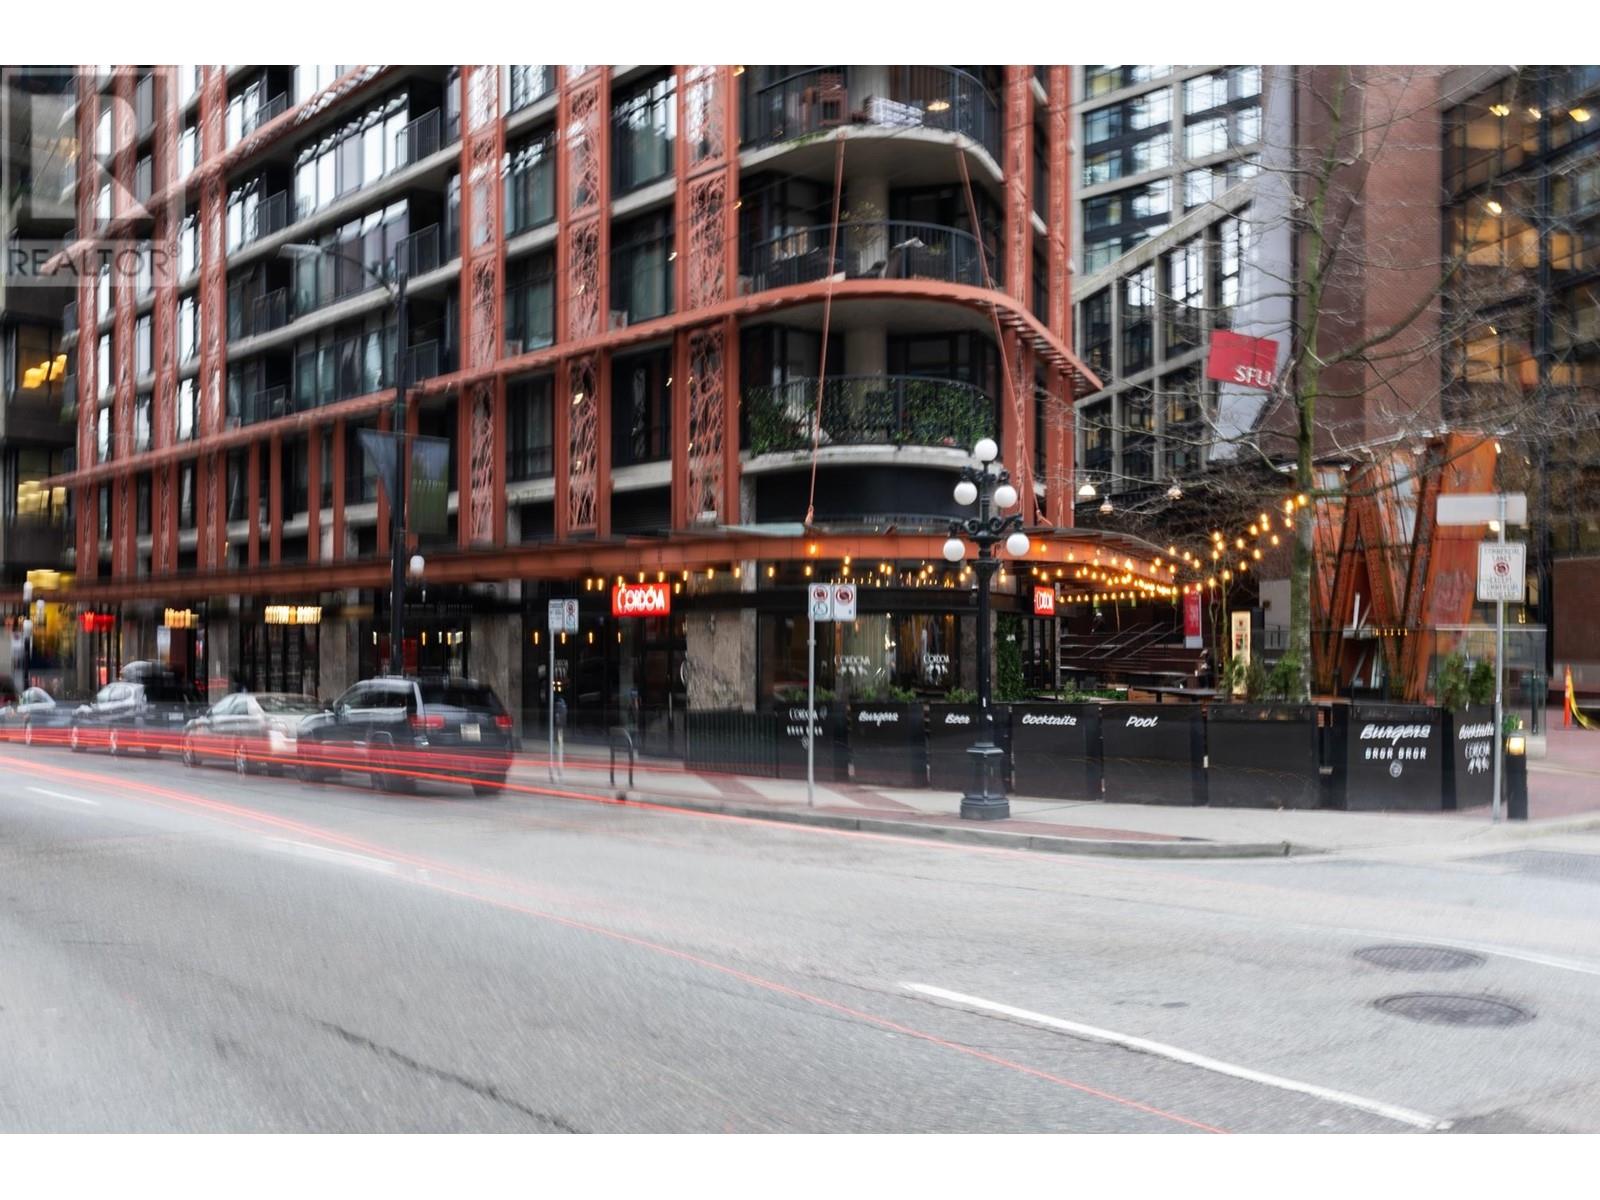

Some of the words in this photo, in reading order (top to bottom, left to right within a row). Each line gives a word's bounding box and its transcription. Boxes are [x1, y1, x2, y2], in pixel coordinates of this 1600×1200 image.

[1233, 364, 1272, 386] SFU
[1021, 714, 1078, 726] Cocktails
[1126, 716, 1159, 727] Pool
[1360, 724, 1432, 746] Burgers
